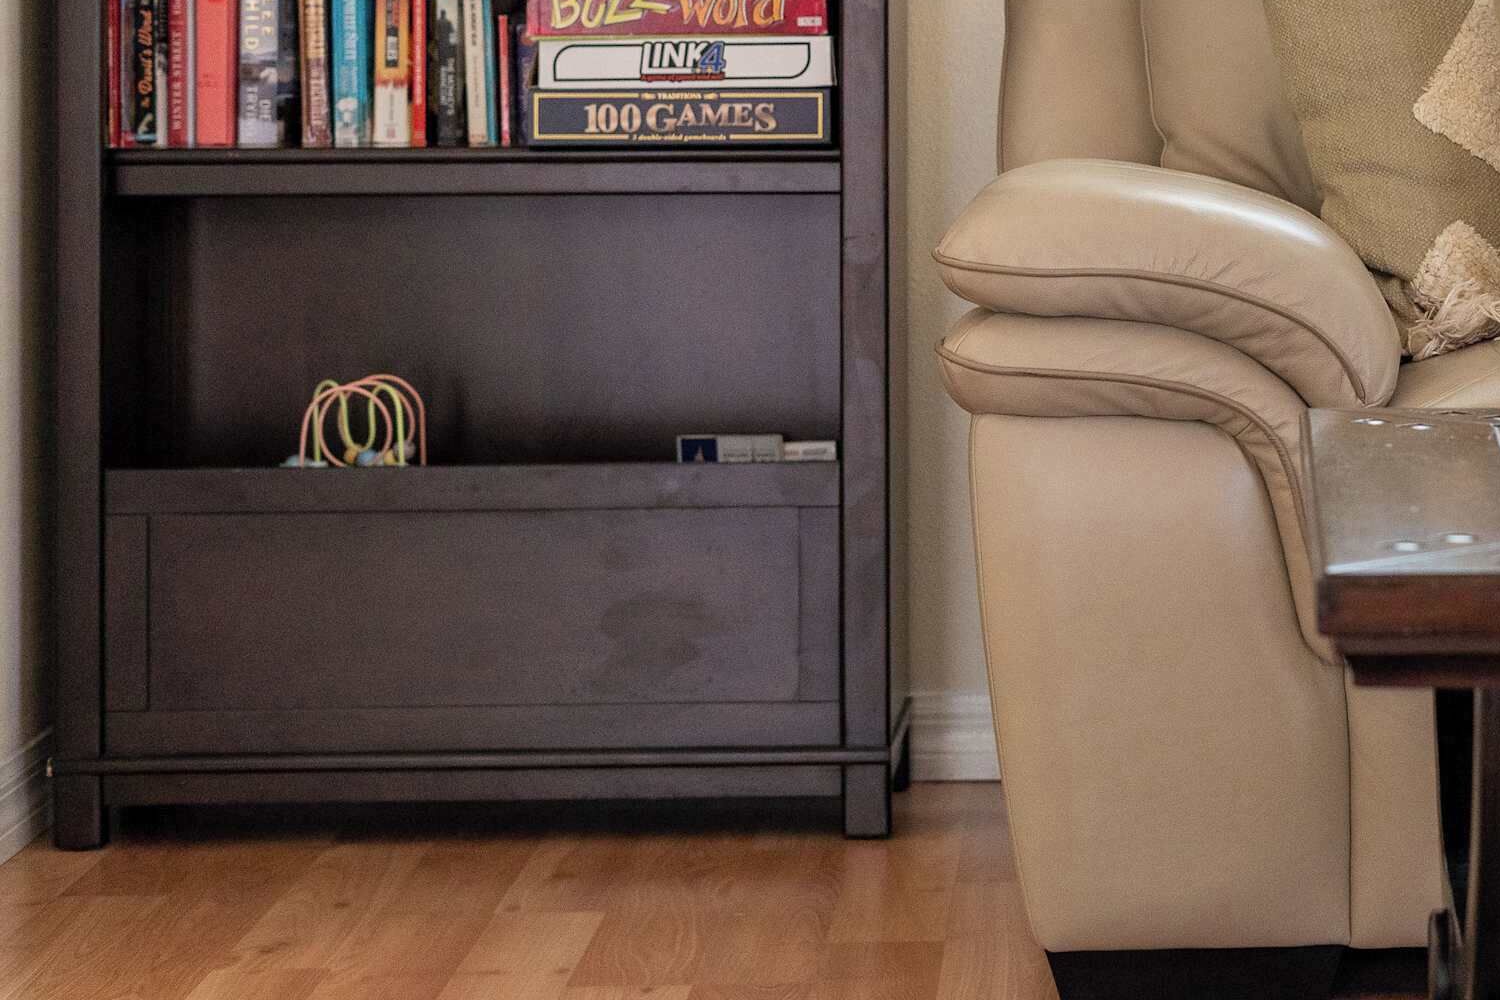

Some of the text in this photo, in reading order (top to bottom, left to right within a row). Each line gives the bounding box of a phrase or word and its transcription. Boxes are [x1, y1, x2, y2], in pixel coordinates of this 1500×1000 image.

[446, 58, 455, 71] THE
[171, 31, 182, 131] WINTER STREET
[657, 92, 703, 100] TRADITIONS
[258, 99, 272, 122] DIE
[584, 102, 777, 133] 100 GAMES
